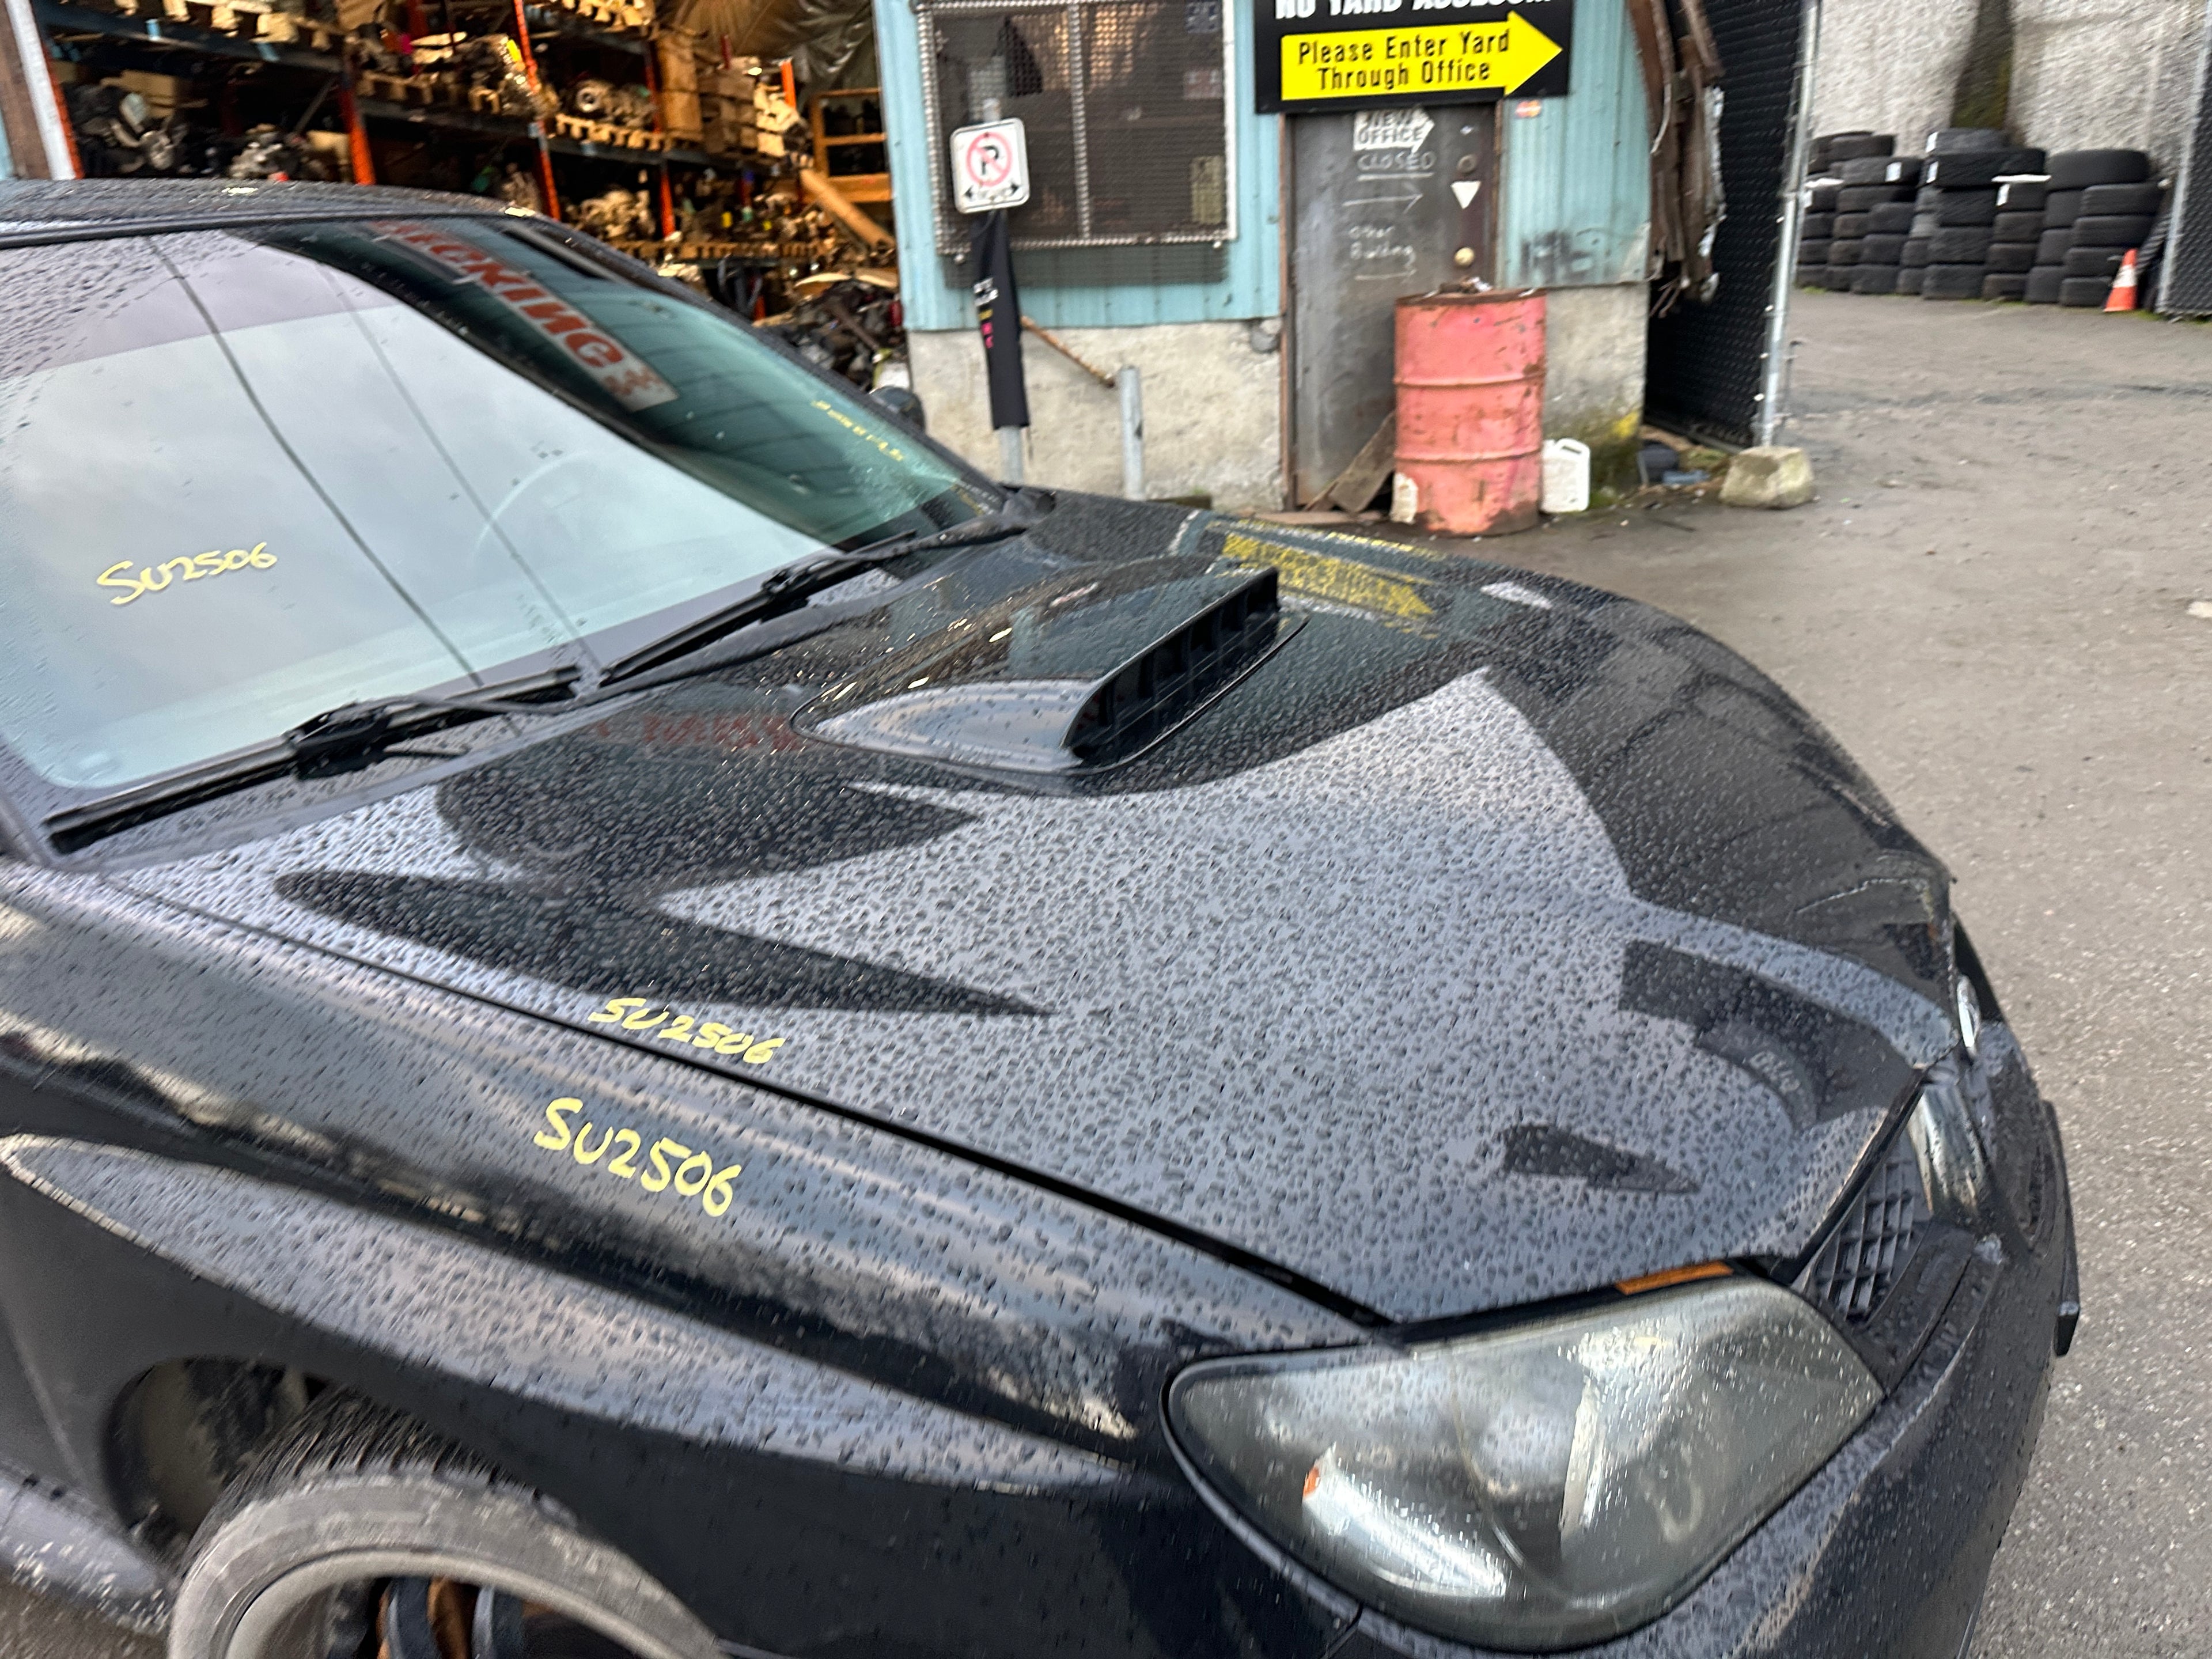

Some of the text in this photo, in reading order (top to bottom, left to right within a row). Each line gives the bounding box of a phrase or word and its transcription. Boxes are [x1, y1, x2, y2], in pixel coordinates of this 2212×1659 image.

[1298, 28, 1510, 65] Please Enter Yard
[1316, 58, 1490, 90] Through Office
[96, 541, 277, 605] SU2506
[588, 997, 786, 1064] SU2506
[533, 1097, 742, 1217] SU2506
